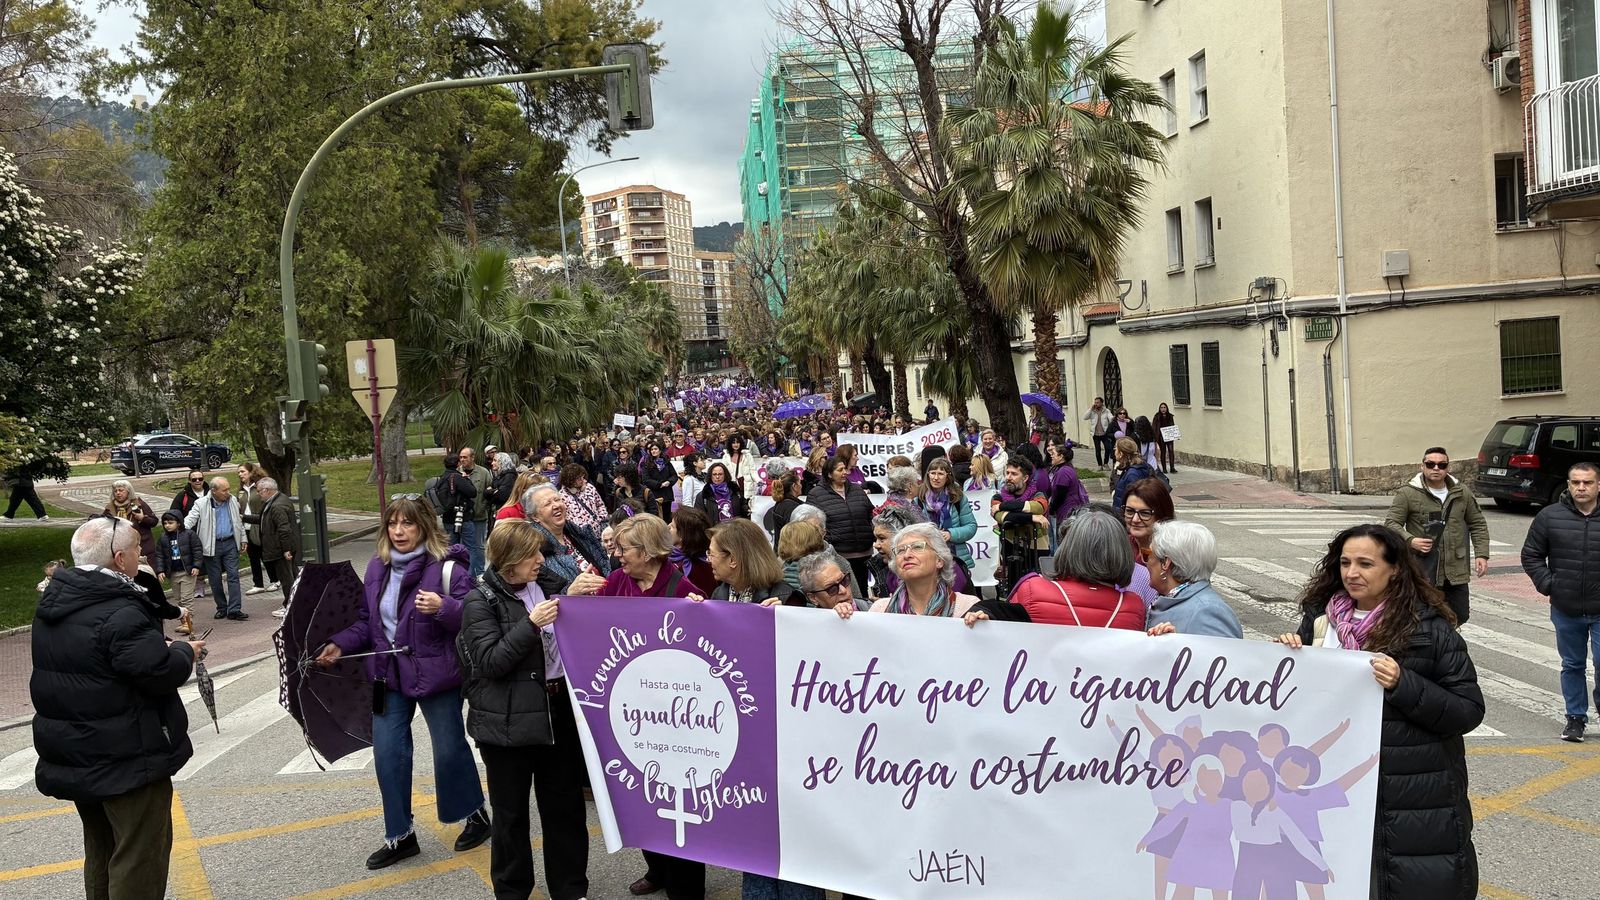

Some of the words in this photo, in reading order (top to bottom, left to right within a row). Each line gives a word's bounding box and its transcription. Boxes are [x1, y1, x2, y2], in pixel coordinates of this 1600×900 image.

[921, 427, 952, 448] 2026
[573, 626, 647, 709] Revuelta
[658, 610, 687, 645] de
[697, 636, 759, 717] mujeres
[640, 678, 669, 690] Hasta
[672, 682, 691, 692] que
[694, 681, 702, 692] la
[790, 657, 905, 714] Hasta
[917, 677, 990, 724] que
[1003, 649, 1057, 714] la
[1070, 646, 1298, 729] igualdad
[622, 695, 725, 736] igualdad
[633, 741, 645, 750] se
[647, 740, 669, 753] haga
[672, 744, 721, 759] costumbre
[803, 756, 844, 791] se
[855, 722, 957, 810] haga
[970, 726, 1190, 796] costumbre
[605, 758, 640, 790] en
[643, 760, 677, 804] la
[685, 767, 768, 823] Iglesia
[908, 848, 985, 886] JAÉN
